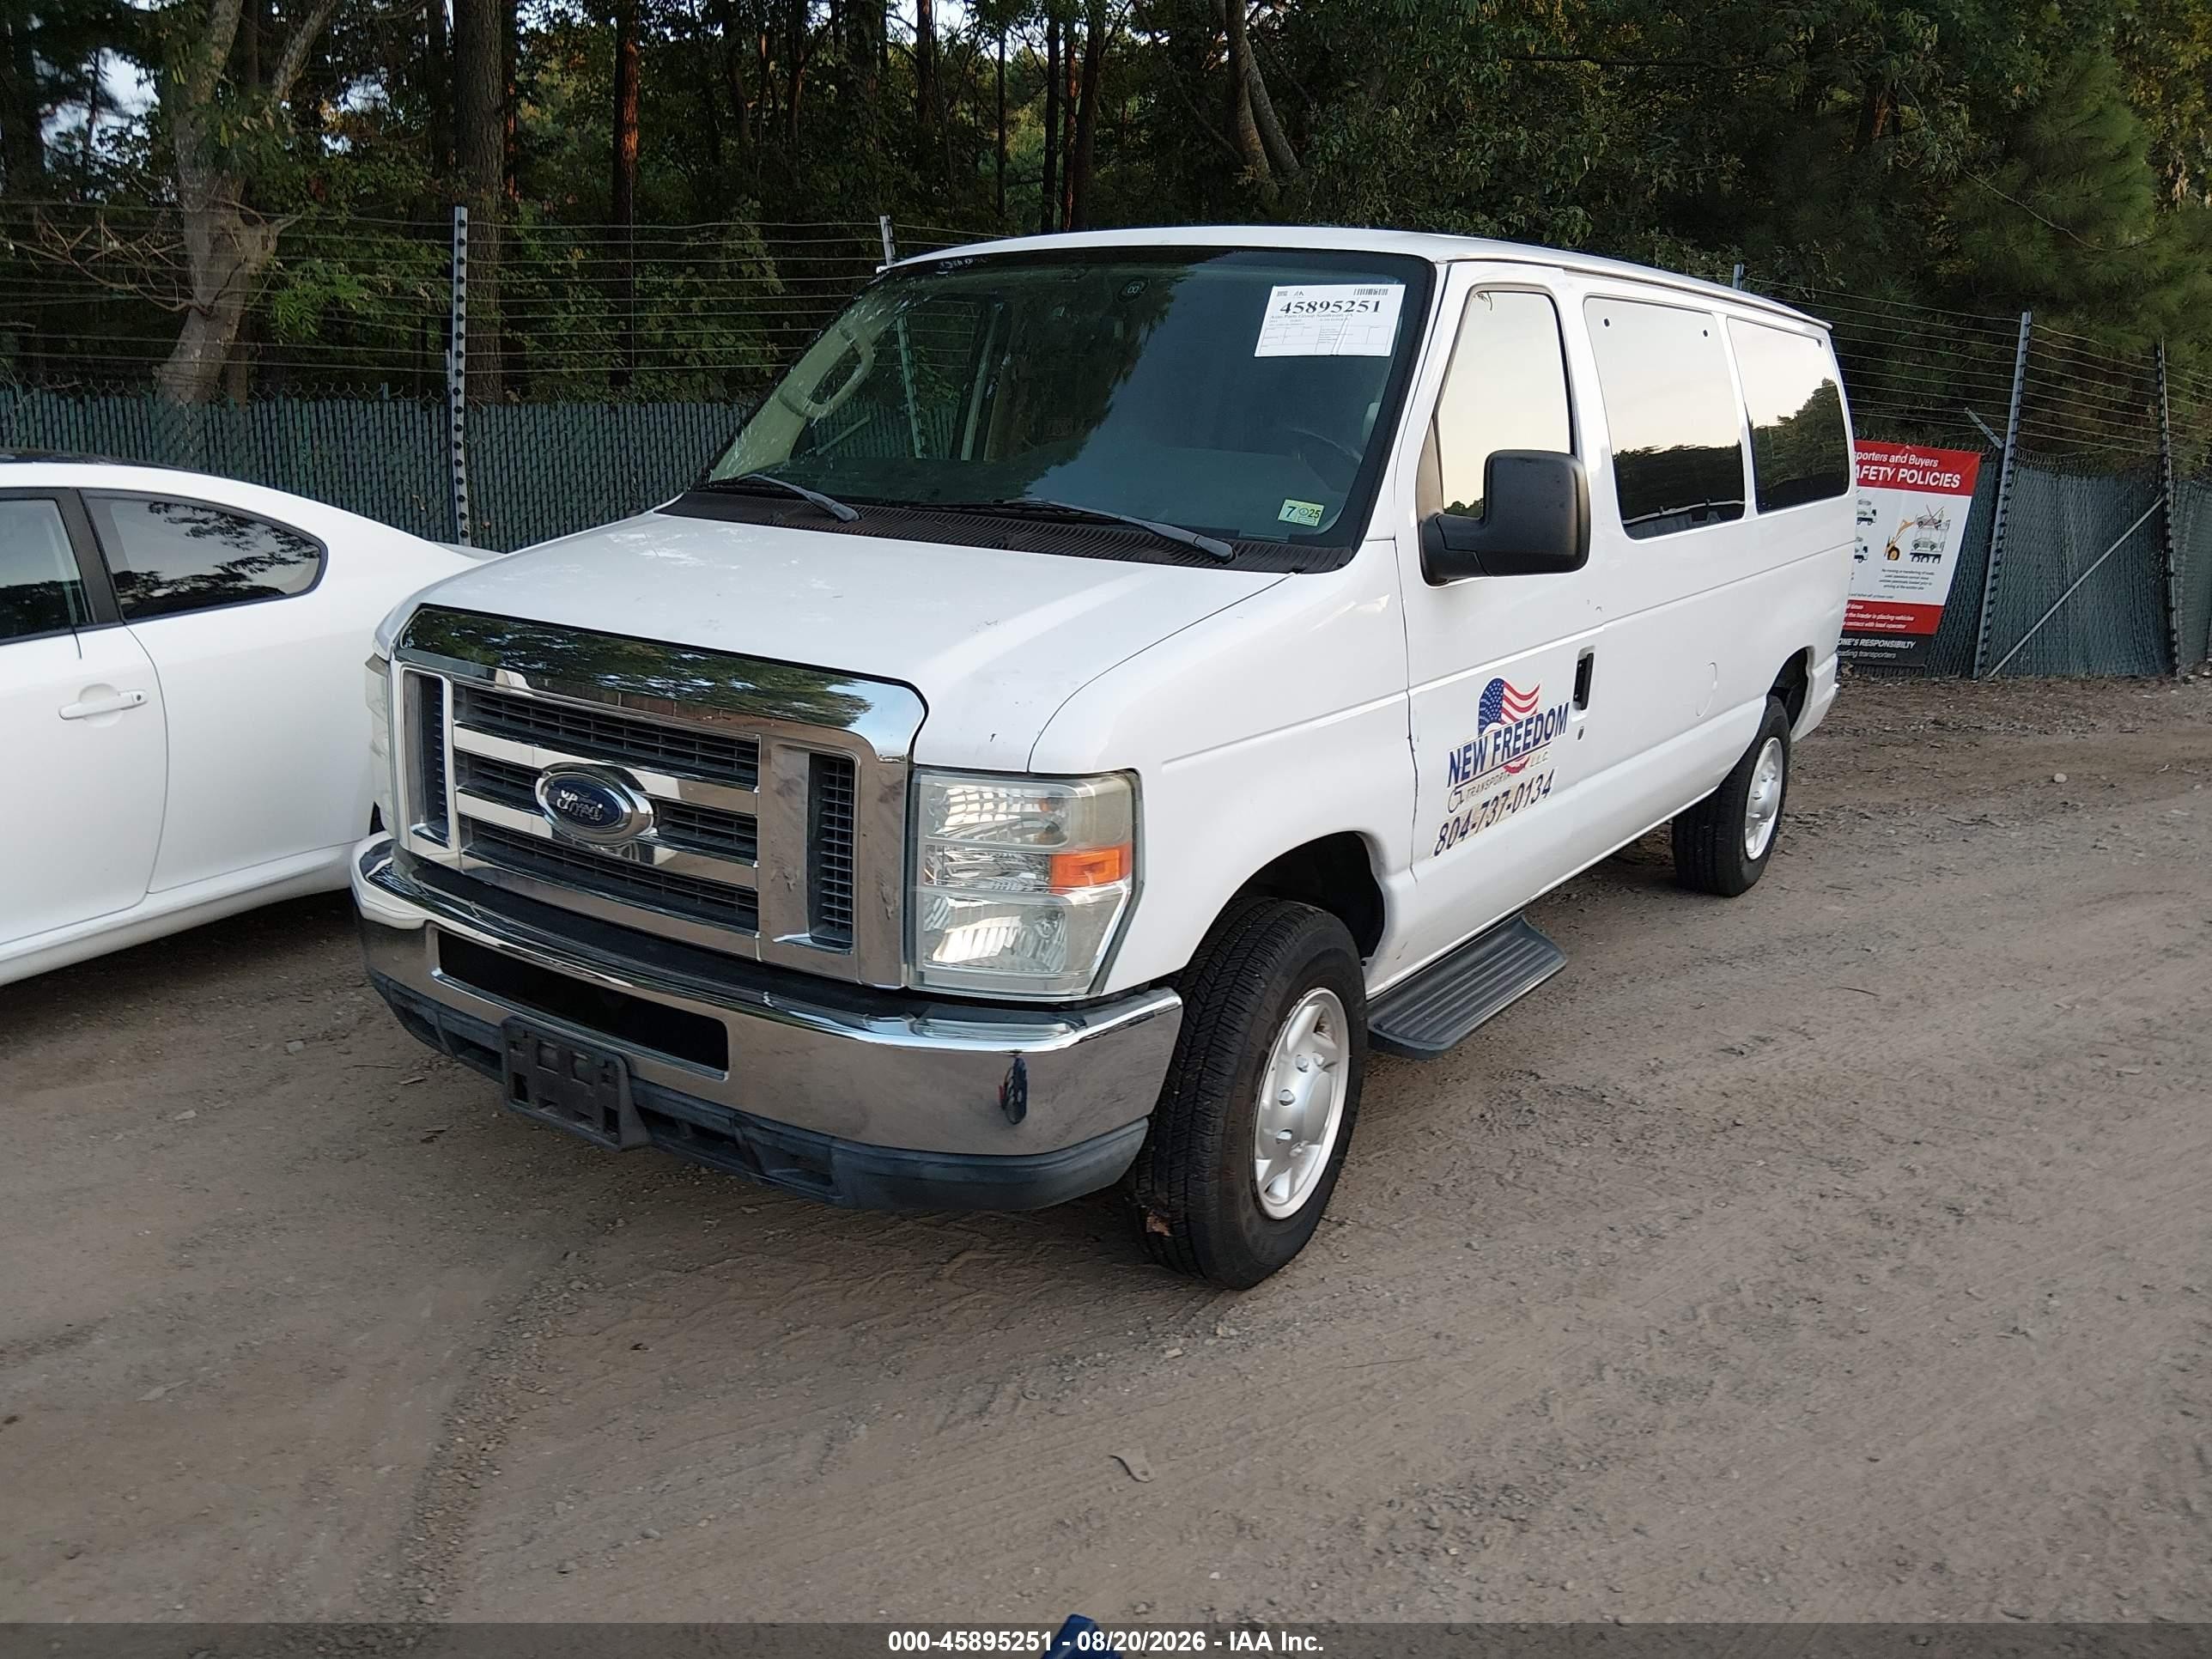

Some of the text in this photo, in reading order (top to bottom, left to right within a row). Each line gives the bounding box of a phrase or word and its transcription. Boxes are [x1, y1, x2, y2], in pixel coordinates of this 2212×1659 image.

[1279, 301, 1382, 314] 45895251
[1889, 453, 1908, 464] and
[1909, 454, 1939, 468] Buyers
[1897, 468, 1961, 489] POLICIES
[1285, 506, 1322, 519] 7 25
[1447, 702, 1570, 787] NEW FREEDOM
[1433, 769, 1555, 857] 804-737-0134
